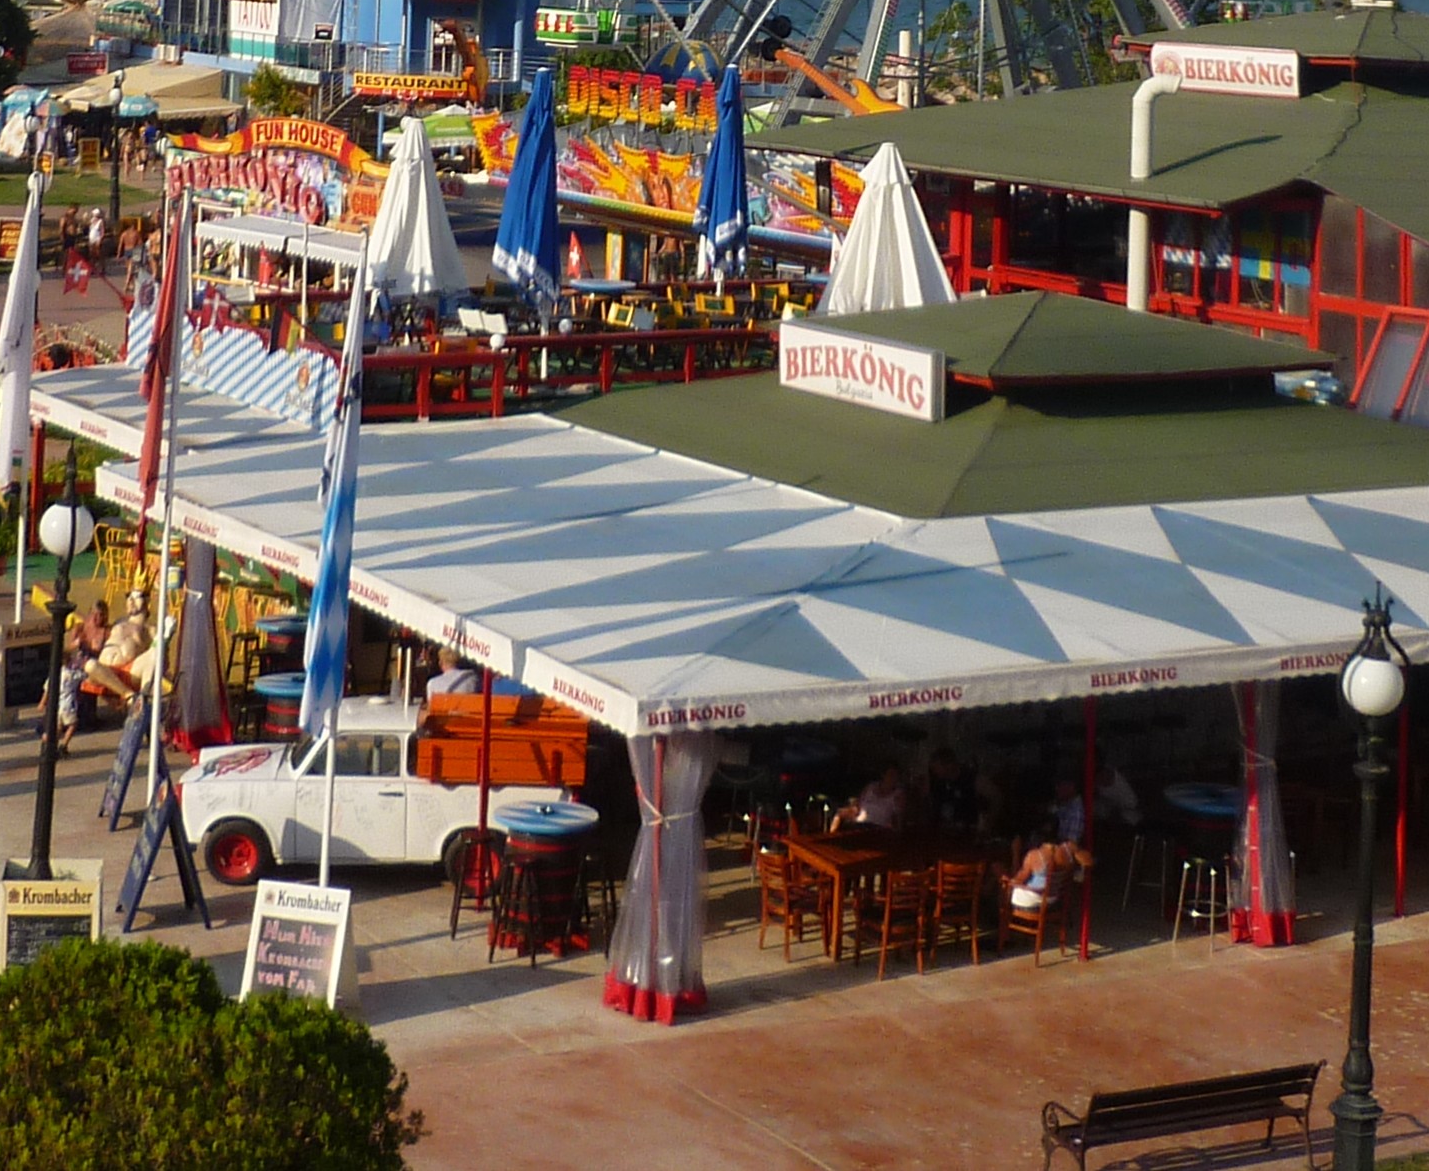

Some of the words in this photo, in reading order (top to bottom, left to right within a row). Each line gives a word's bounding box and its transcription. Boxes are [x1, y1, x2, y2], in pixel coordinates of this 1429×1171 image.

[355, 75, 465, 90] RESTAURANT
[1184, 56, 1294, 88] BIERKÖNIG
[568, 65, 663, 125] DISCO
[675, 78, 718, 132] CA
[256, 123, 284, 142] FUN
[288, 123, 340, 153] HOUSE
[785, 343, 925, 411] BIERKÖNIG
[22, 887, 93, 905] Krombacher
[277, 889, 343, 913] Krombacher
